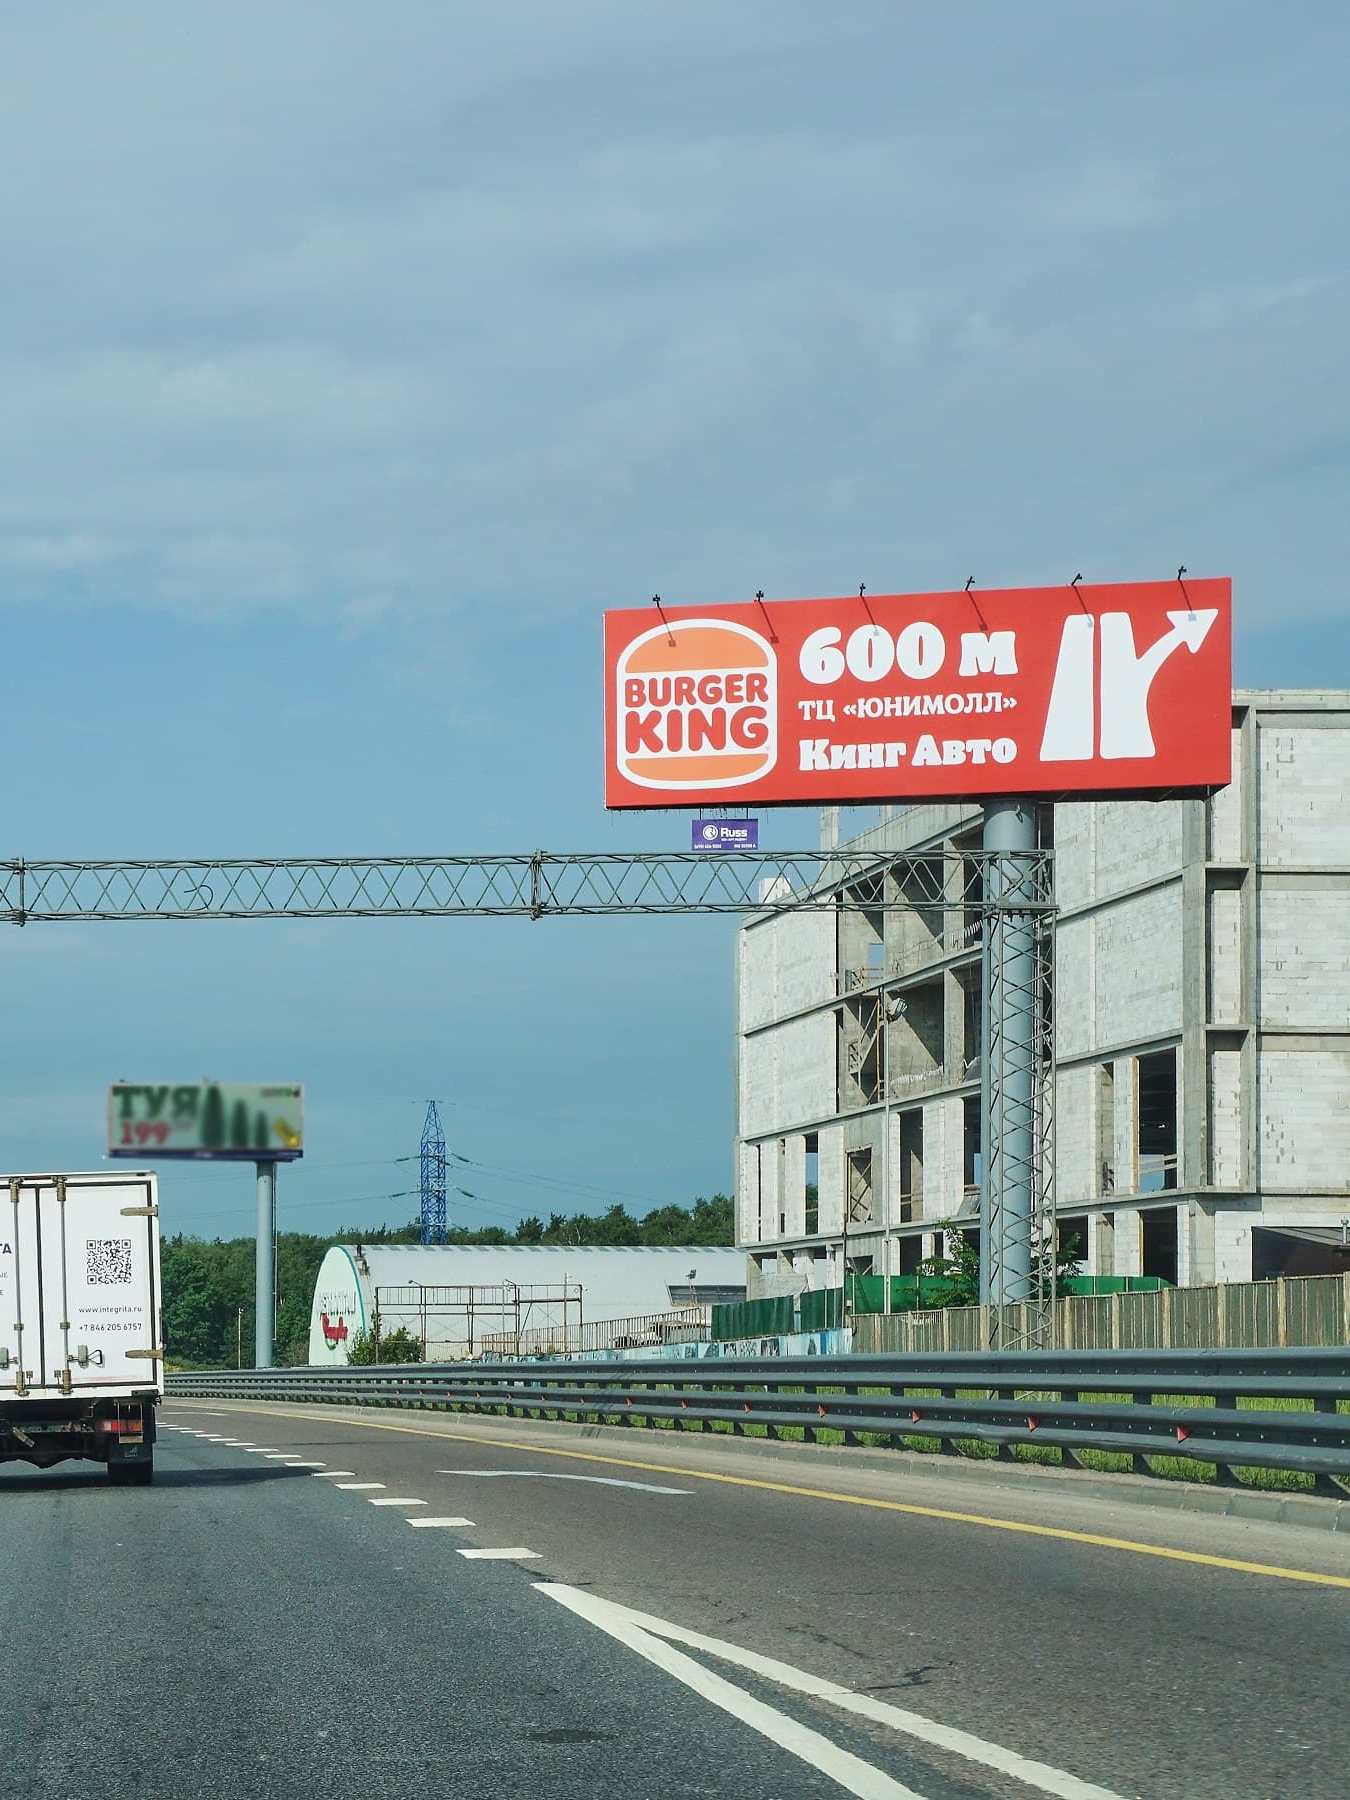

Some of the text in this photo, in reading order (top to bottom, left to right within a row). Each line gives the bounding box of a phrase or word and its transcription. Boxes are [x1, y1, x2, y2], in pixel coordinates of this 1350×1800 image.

[799, 621, 946, 685] 600
[625, 673, 769, 708] BURGER
[798, 692, 1018, 723] ТЦ «ЮНИМОЛЛ»
[625, 705, 769, 754] KING
[799, 734, 1018, 771] Кинг Авто
[720, 827, 748, 838] Russ
[112, 1085, 200, 1119] ТУЯ
[78, 1305, 143, 1315] www.integrita.ru
[106, 1323, 122, 1331] 205
[123, 1322, 142, 1331] 6757
